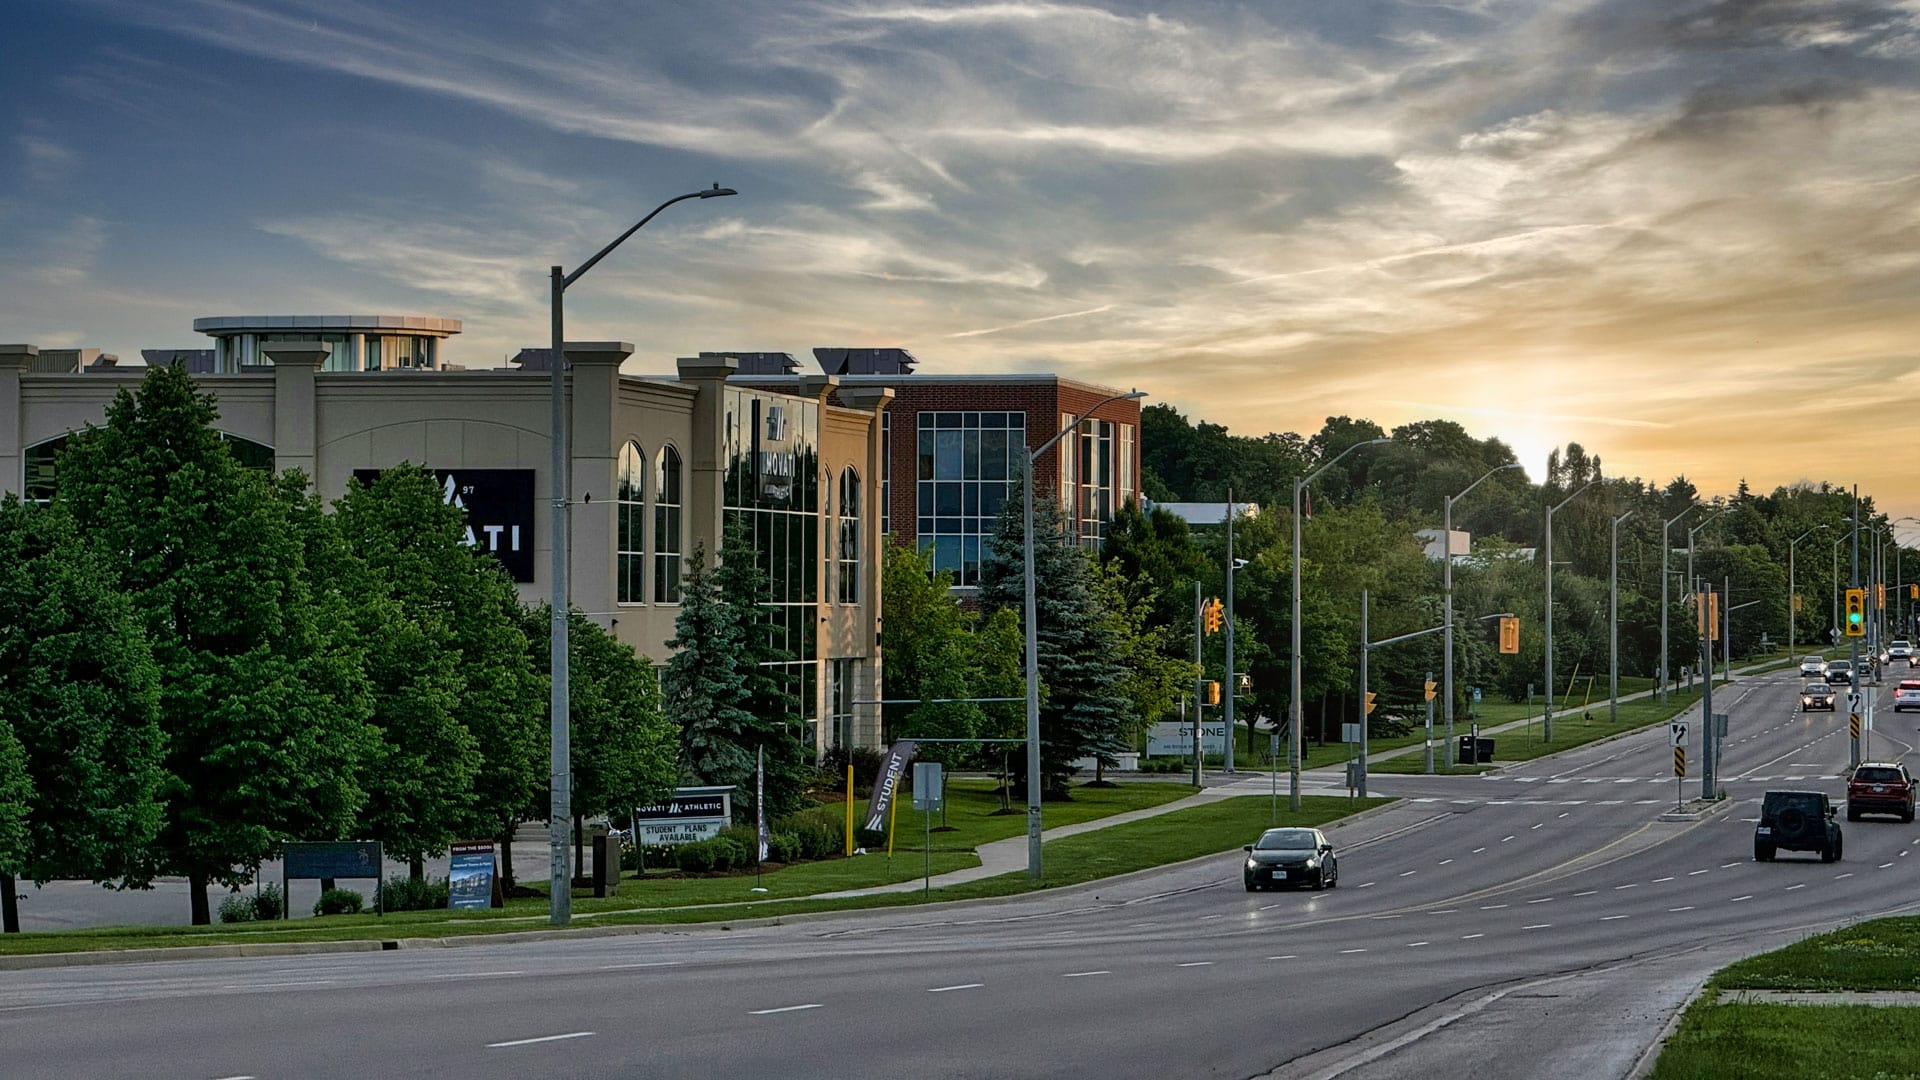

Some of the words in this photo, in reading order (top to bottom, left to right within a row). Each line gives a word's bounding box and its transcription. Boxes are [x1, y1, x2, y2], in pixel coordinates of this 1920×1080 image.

[462, 485, 475, 495] 97
[456, 525, 520, 551] ATI
[877, 753, 902, 811] STUDENT
[684, 803, 722, 811] ATHLETIC
[646, 825, 677, 834] STUDENT
[684, 824, 707, 833] PLANS
[659, 833, 697, 841] AVAILABLE
